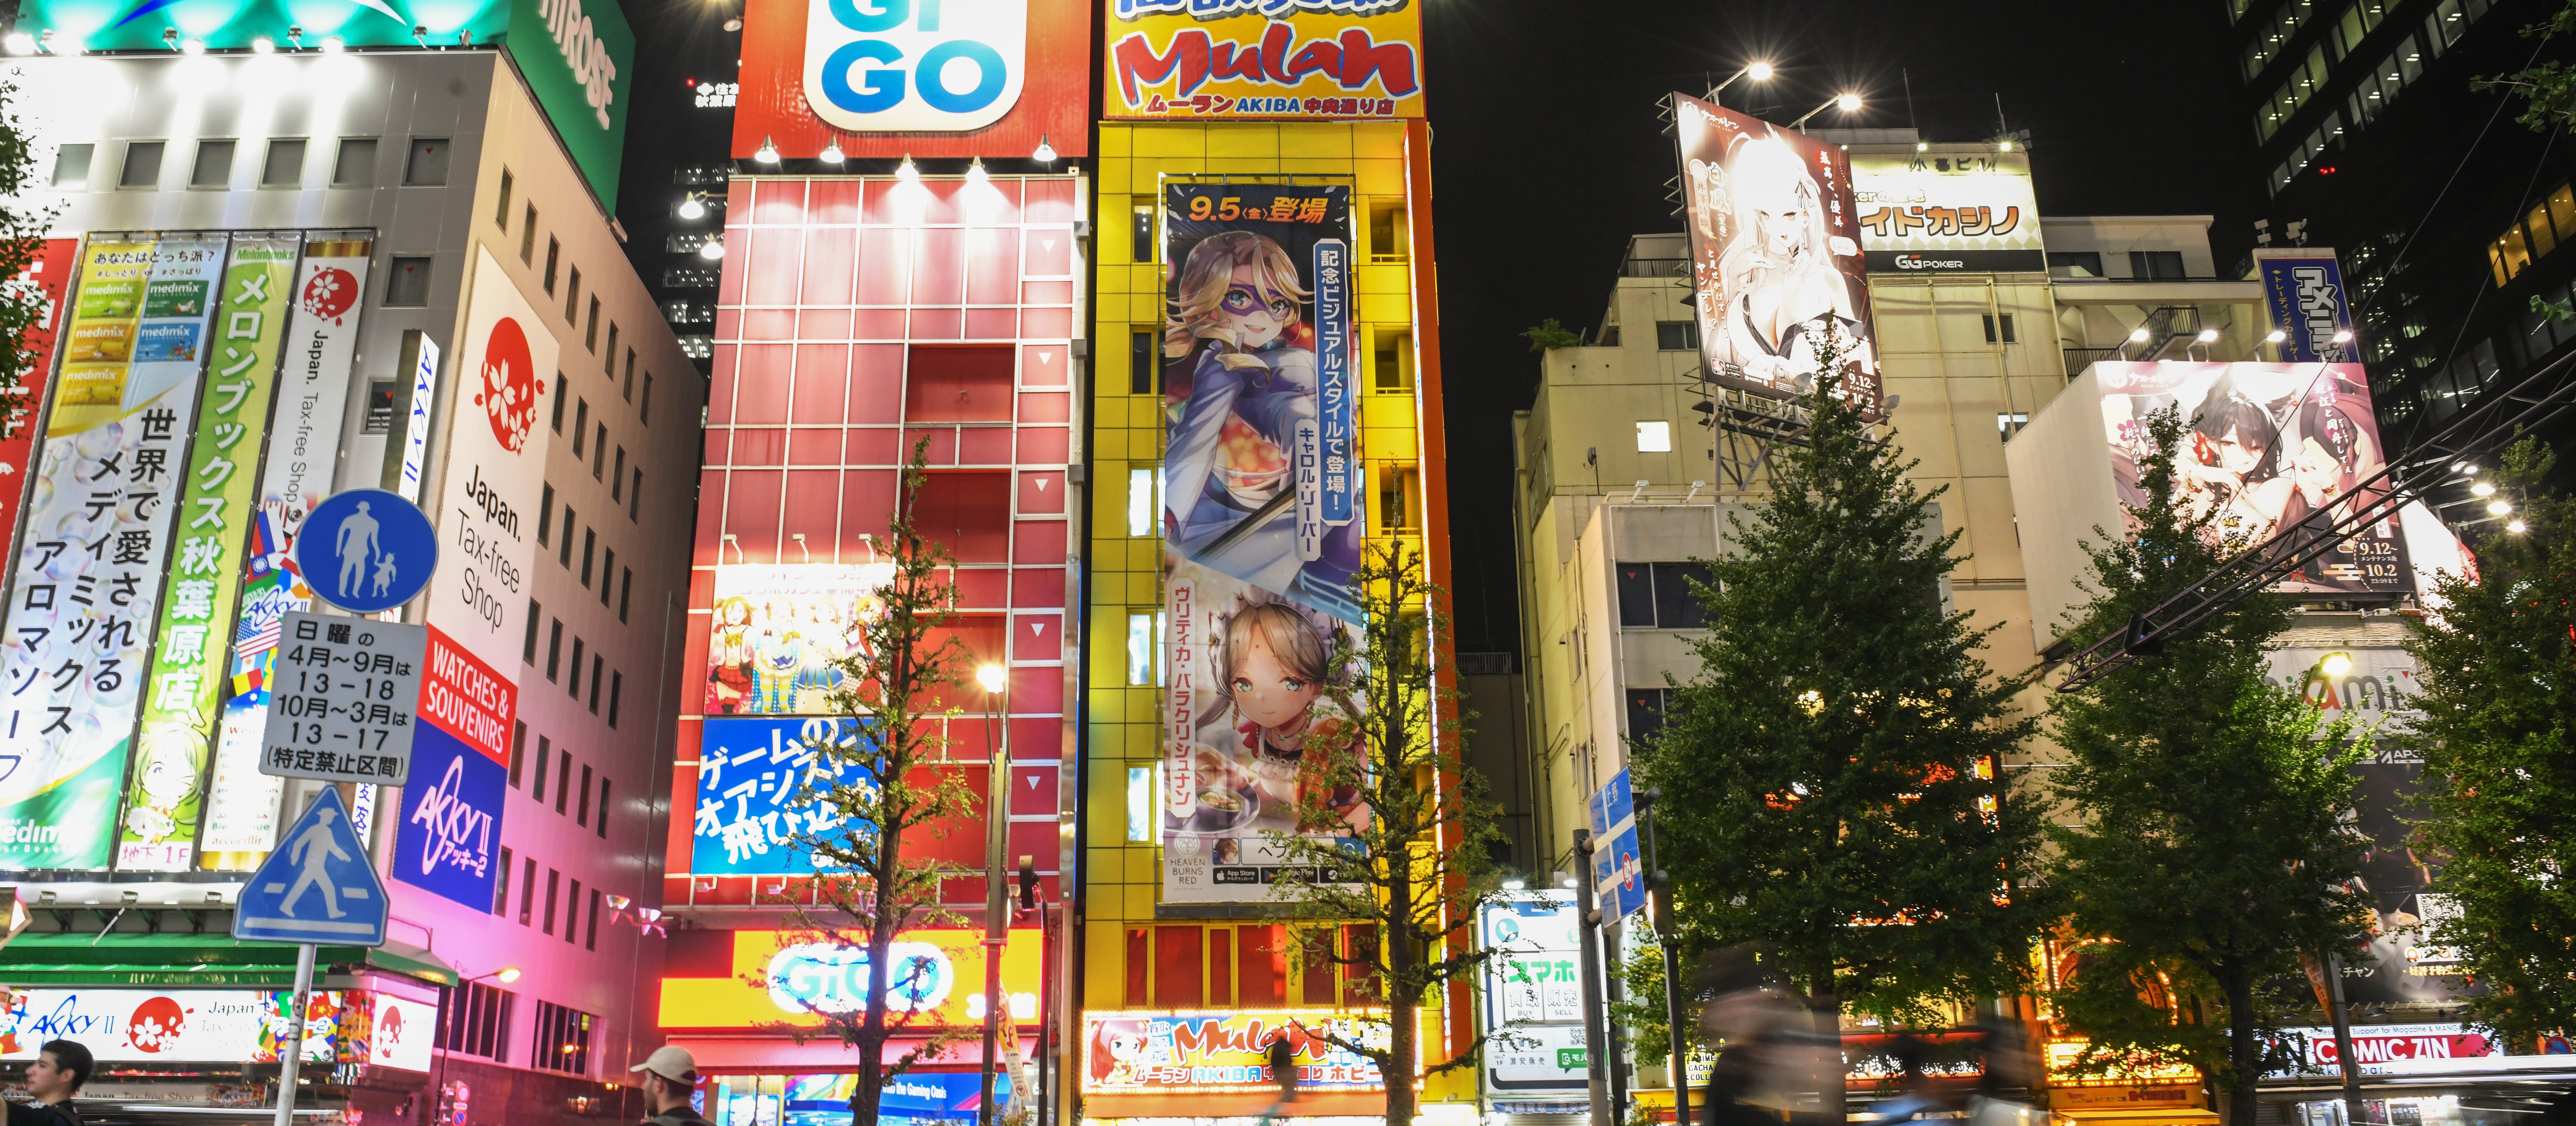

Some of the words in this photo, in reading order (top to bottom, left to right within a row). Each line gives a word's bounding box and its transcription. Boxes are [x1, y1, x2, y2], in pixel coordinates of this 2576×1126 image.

[822, 39, 1007, 113] GO
[1115, 22, 1419, 106] Mulan
[236, 249, 295, 260] Melonbooks
[150, 281, 200, 294] medimix
[141, 324, 190, 337] medimix
[305, 330, 328, 385] Japan.
[293, 392, 319, 457] Tax-free
[154, 273, 270, 711] メロンブックス秋葉原店
[283, 461, 306, 503] Shop
[466, 464, 521, 543] Japan.
[93, 408, 177, 692] 世界で愛される
[458, 508, 519, 593] Tax-free
[2365, 564, 2397, 577] 10.2
[40, 451, 123, 735] メディミックス
[462, 568, 503, 634] Shop
[296, 620, 375, 646] 日曜の
[433, 640, 497, 711] WATCHES
[426, 681, 505, 754] SOUVENIRS
[1509, 960, 1575, 982] スマホ
[2393, 1024, 2426, 1034] Magazine
[2410, 1037, 2451, 1059] ZIN
[907, 1082, 930, 1100] Gaming
